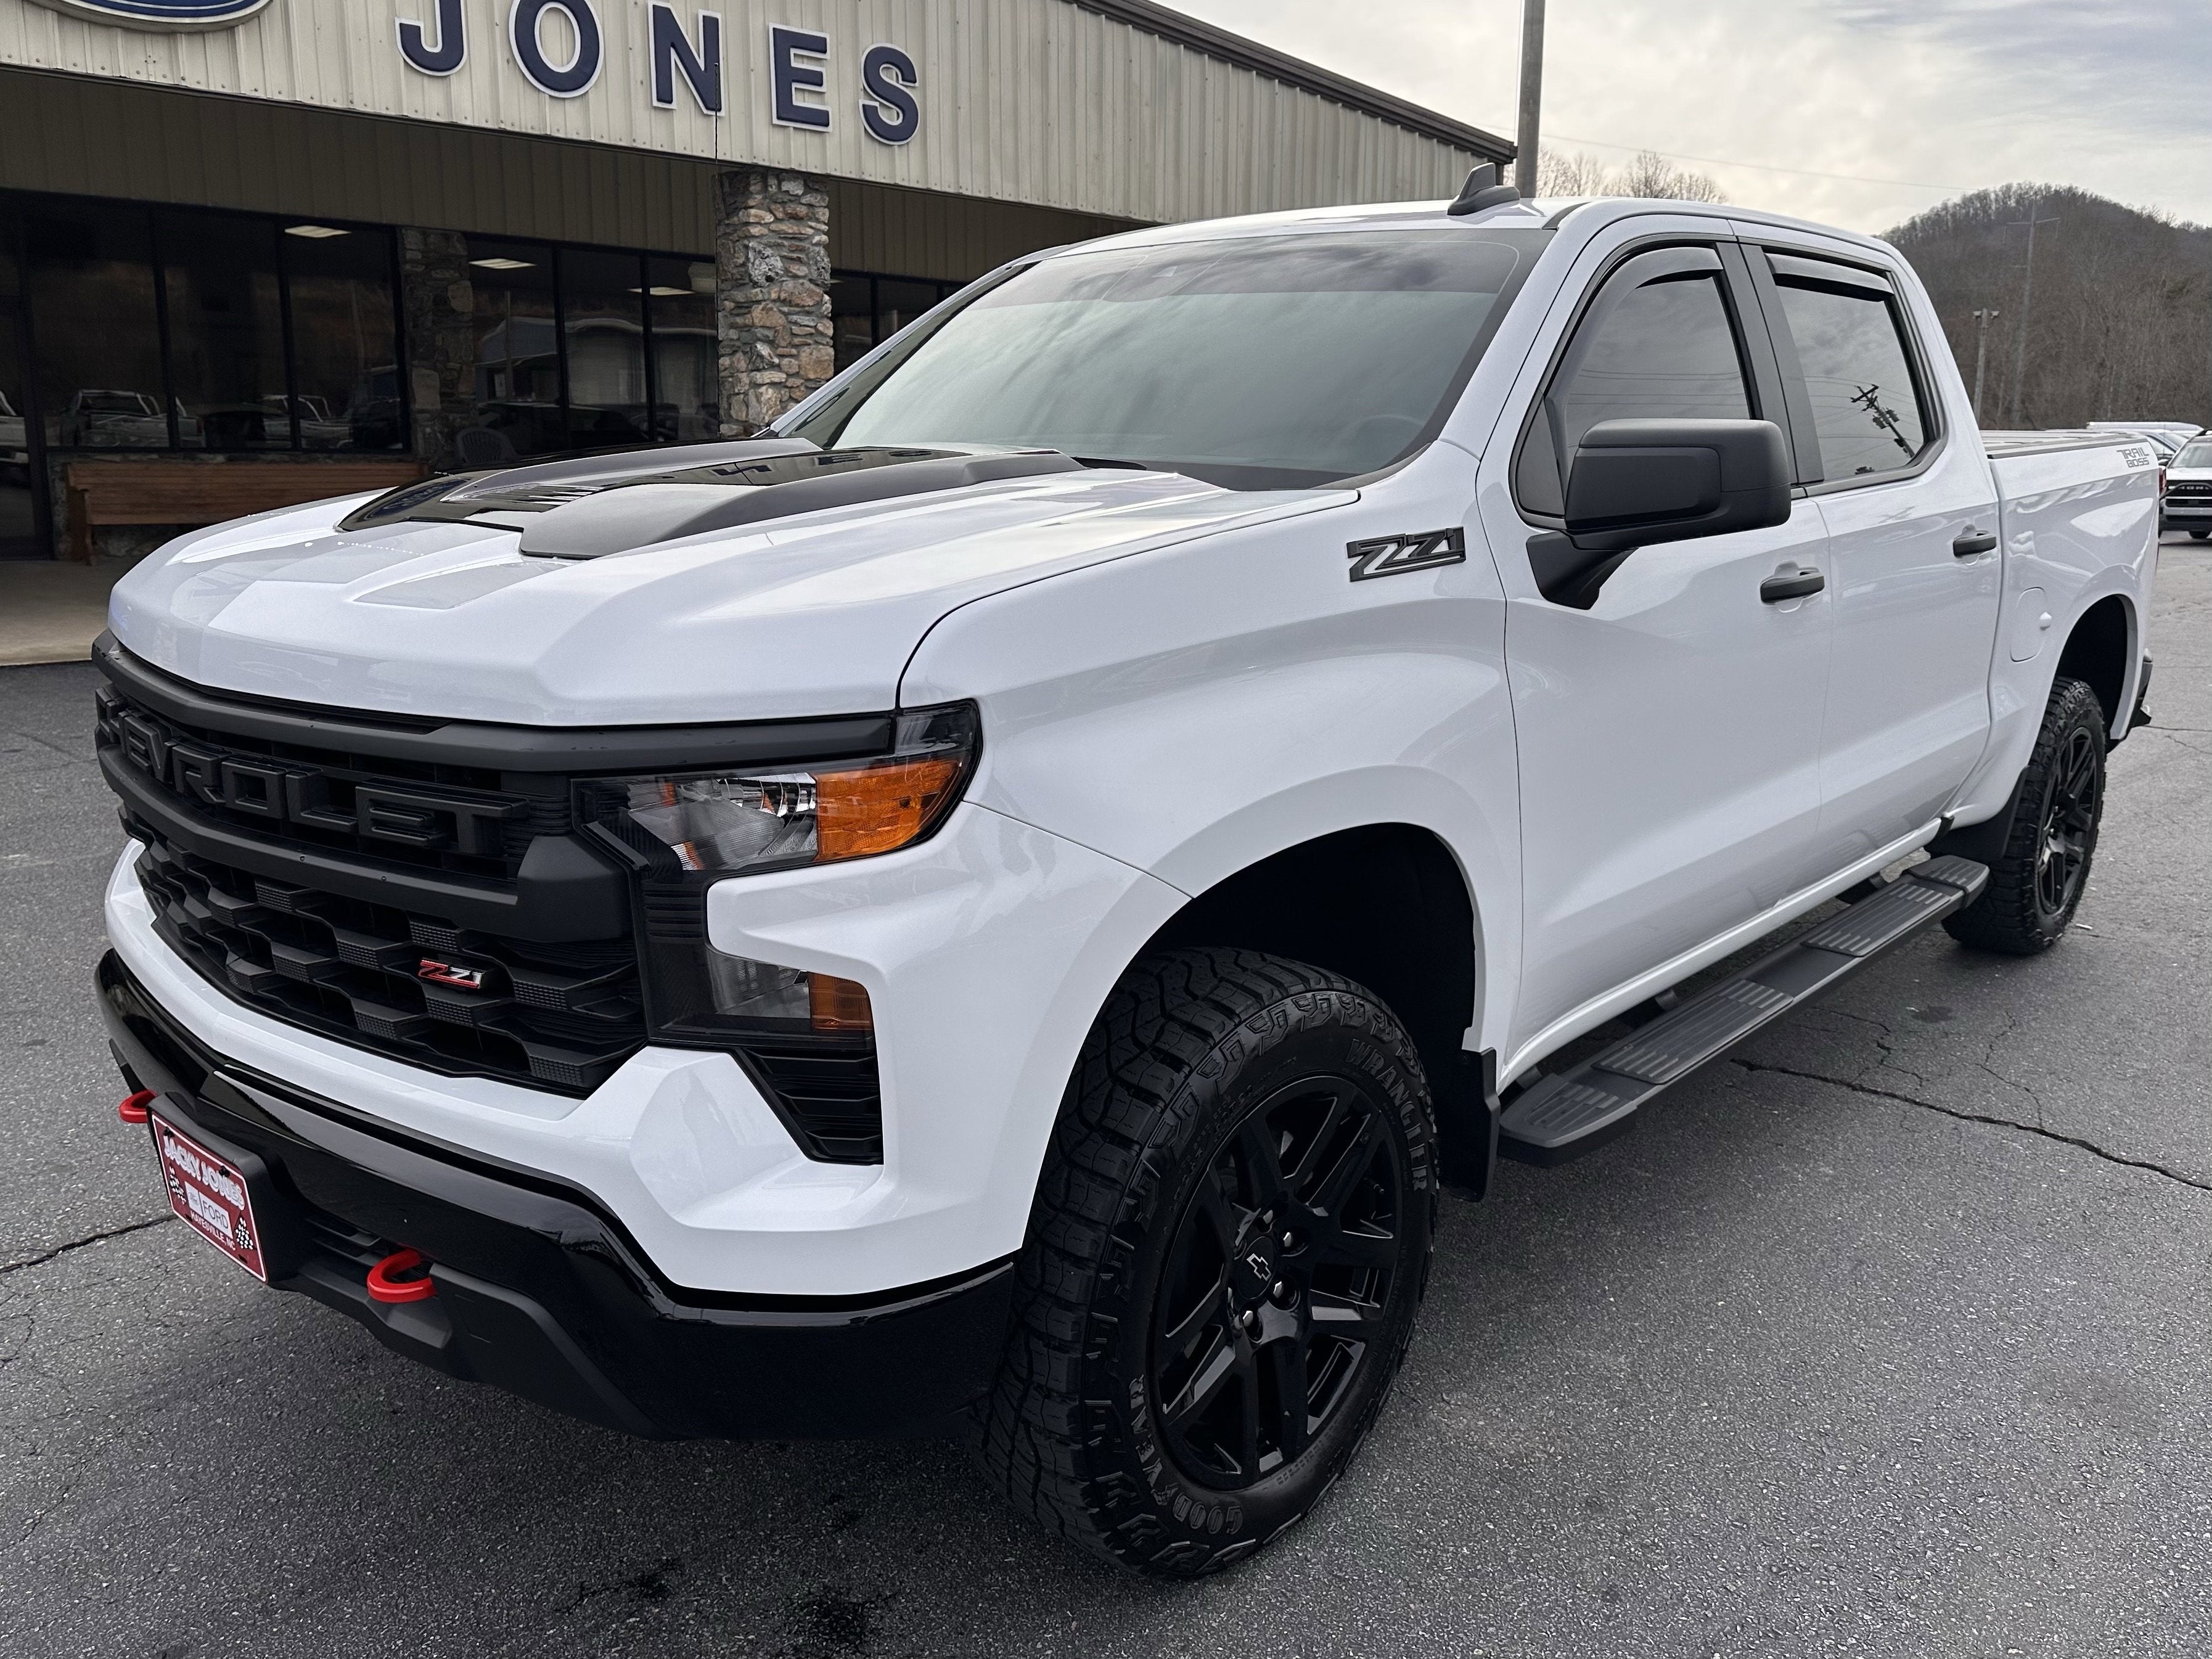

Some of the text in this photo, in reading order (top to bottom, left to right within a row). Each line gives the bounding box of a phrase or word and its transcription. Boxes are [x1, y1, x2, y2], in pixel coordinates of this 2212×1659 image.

[395, 0, 920, 145] JONES
[2116, 447, 2149, 459] TRAIL
[2126, 457, 2149, 468] BOSS
[1346, 526, 1466, 582] Z71
[418, 959, 485, 989] Z71
[1346, 1039, 1427, 1190] WRANGLER
[163, 1136, 245, 1210] JACKY JONES
[202, 1200, 228, 1229] FORD
[1129, 1374, 1243, 1534] GOODYEAR
